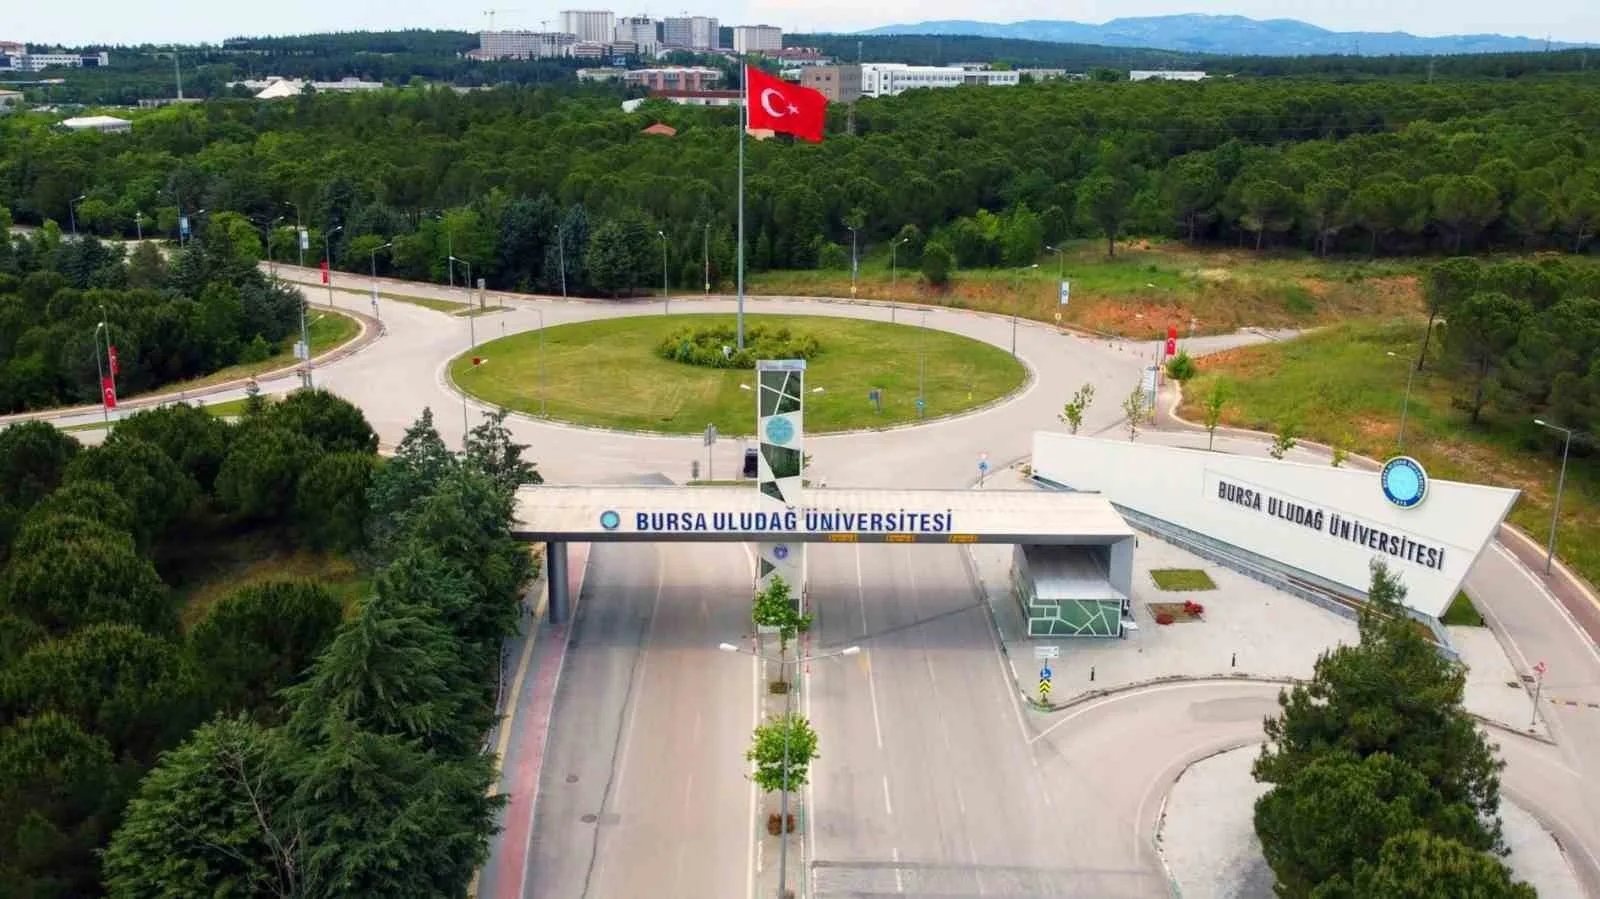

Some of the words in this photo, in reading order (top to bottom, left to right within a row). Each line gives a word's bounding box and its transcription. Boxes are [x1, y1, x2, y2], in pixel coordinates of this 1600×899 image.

[636, 511, 707, 531] BURSA
[713, 505, 797, 531] ULUDAĞ
[806, 507, 952, 532] ÜNİVERSİTESİ
[1218, 480, 1261, 511] BURSA
[1267, 496, 1324, 532] ULUDAĞ
[1329, 513, 1445, 570] ÜNİVERSİTESİ
